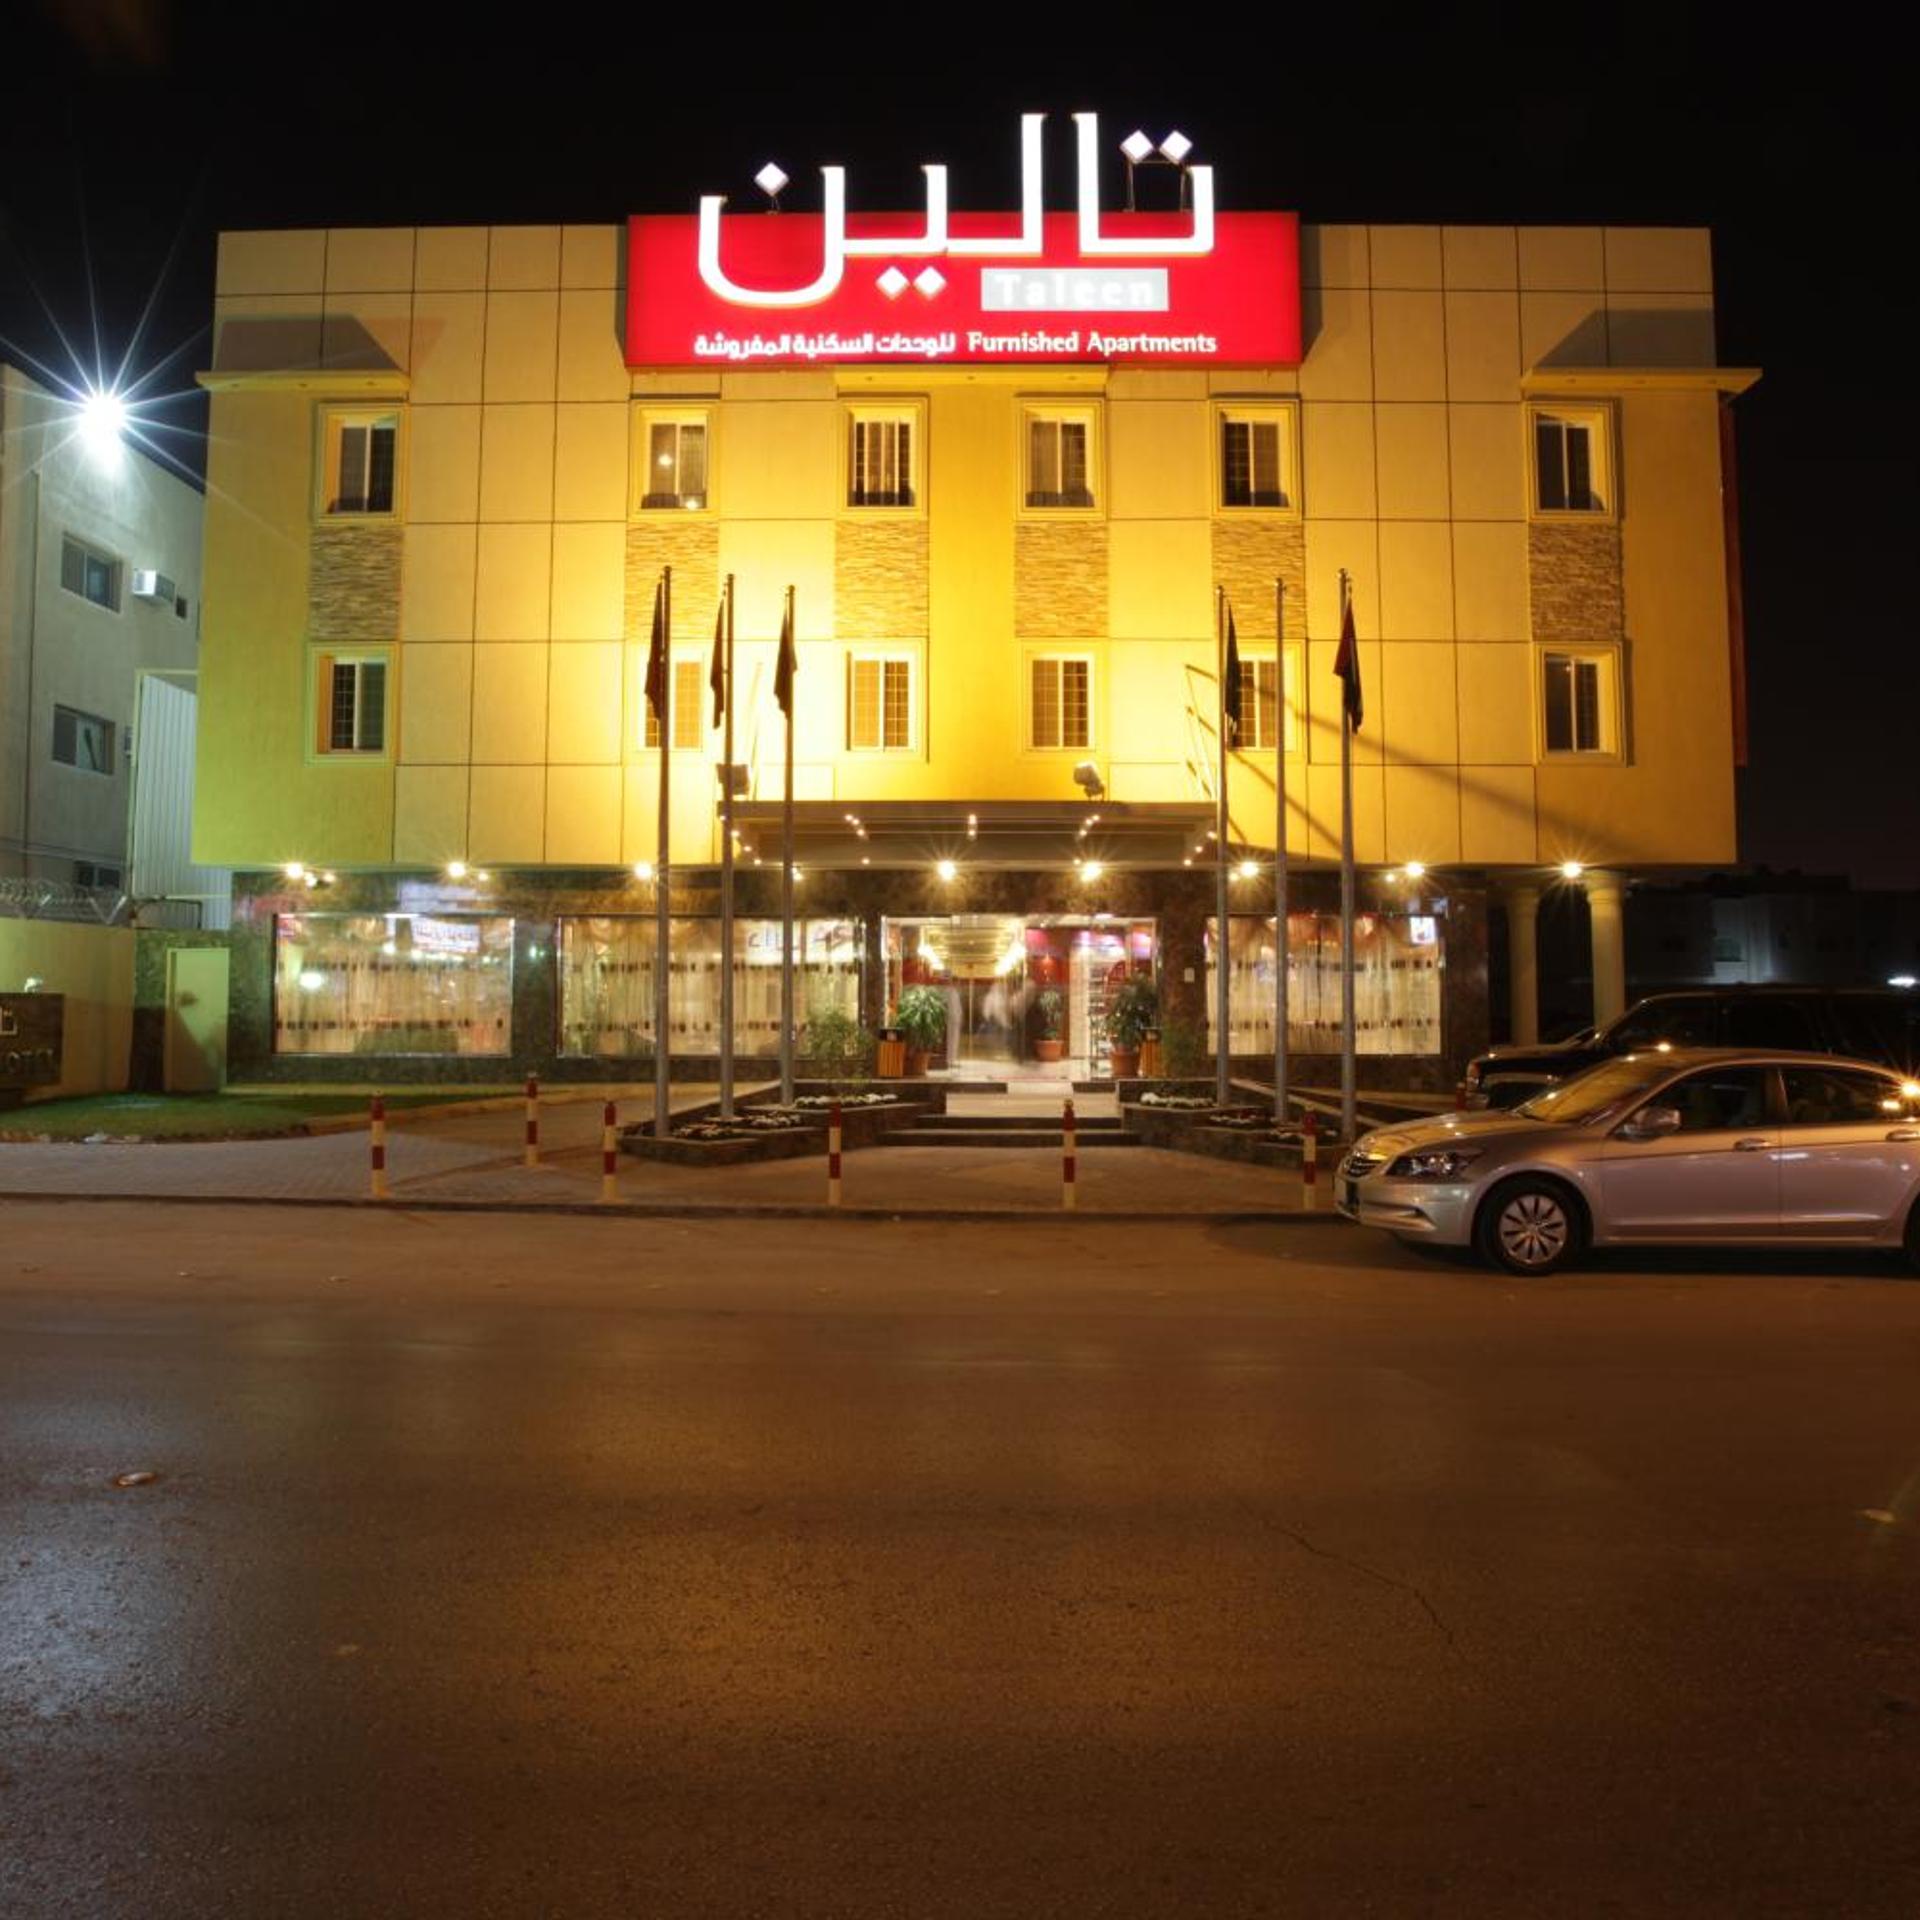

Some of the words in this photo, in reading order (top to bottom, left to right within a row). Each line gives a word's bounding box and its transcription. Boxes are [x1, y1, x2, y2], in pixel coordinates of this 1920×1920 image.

[698, 112, 1214, 308] تالين
[994, 273, 1154, 307] Taleen
[694, 332, 791, 359] المفروشة
[792, 332, 874, 358] السكنية
[875, 332, 956, 358] للوحدات
[967, 331, 1079, 352] Furnished
[1087, 331, 1217, 356] Apartments
